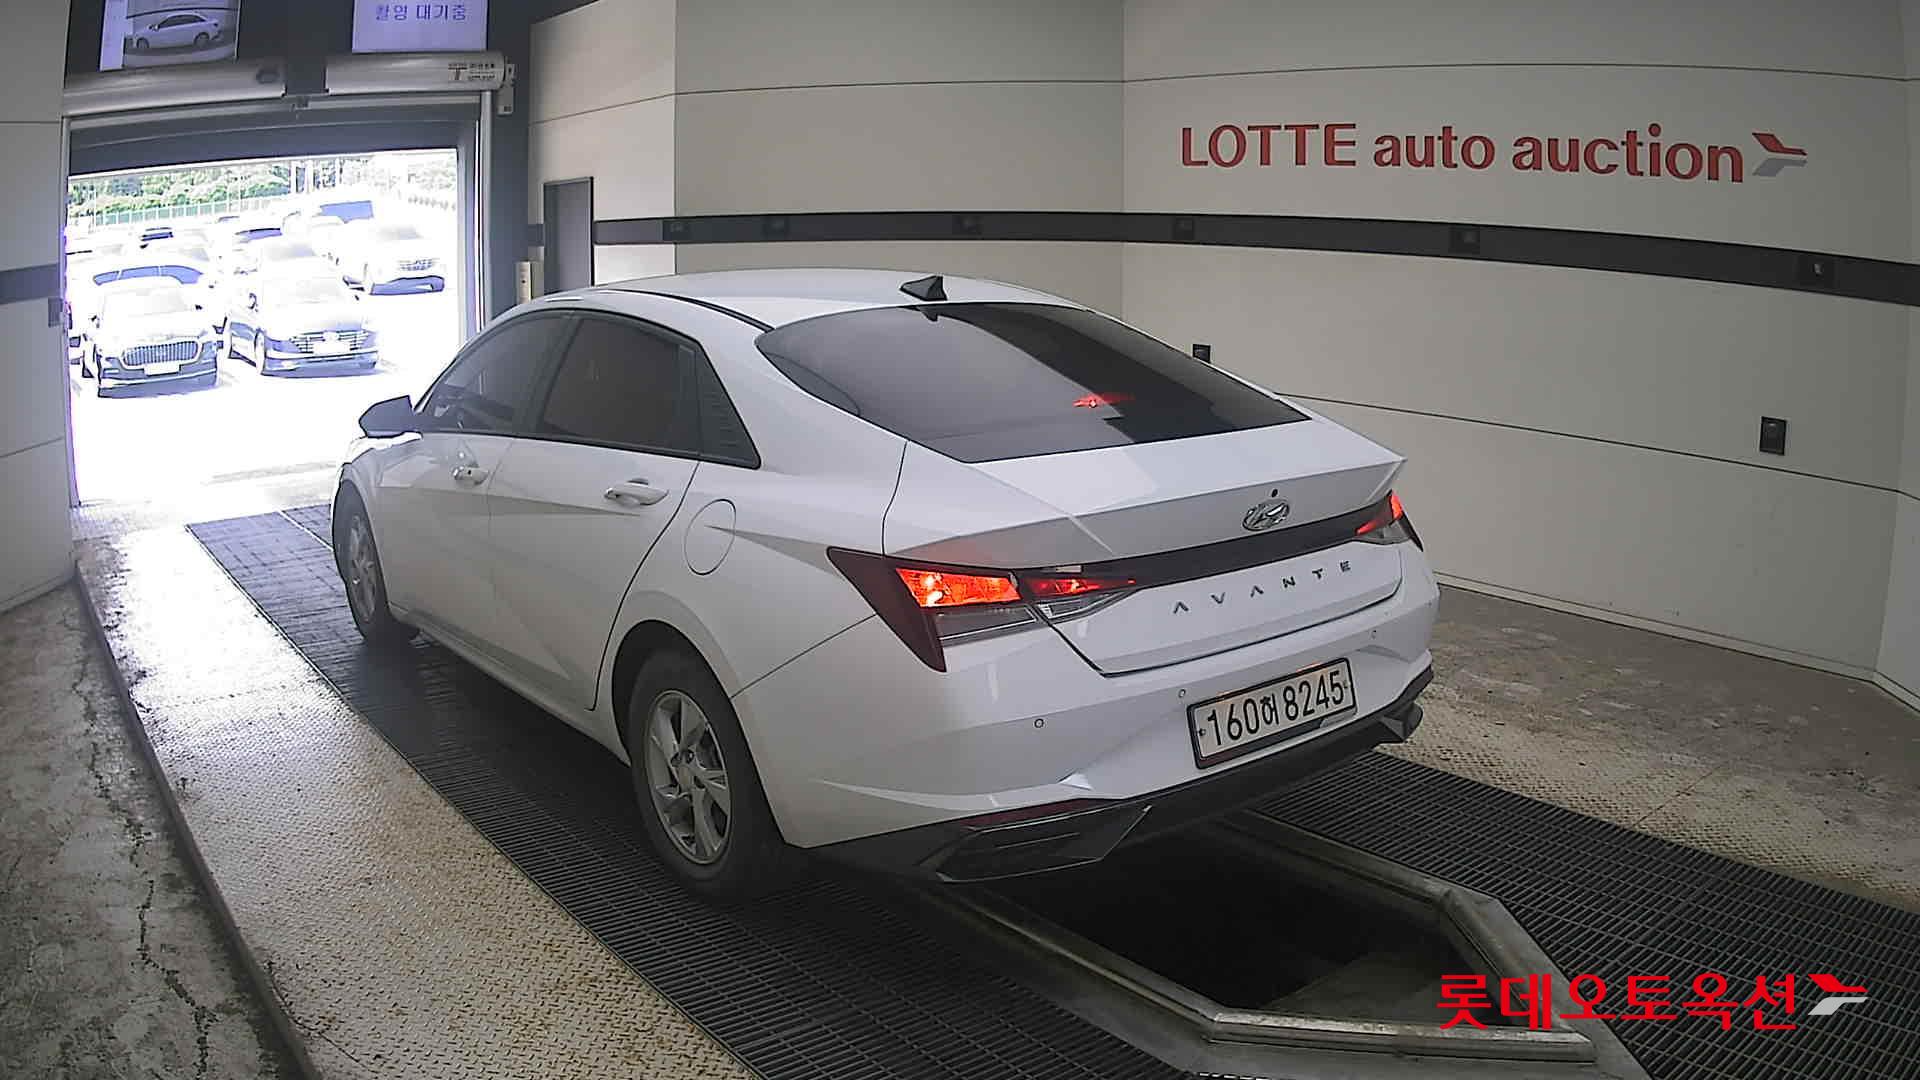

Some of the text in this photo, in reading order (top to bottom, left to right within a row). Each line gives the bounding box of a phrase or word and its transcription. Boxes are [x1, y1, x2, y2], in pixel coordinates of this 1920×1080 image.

[1180, 122, 1743, 184] LOTTE auto auction
[1172, 560, 1352, 615] AVANTE
